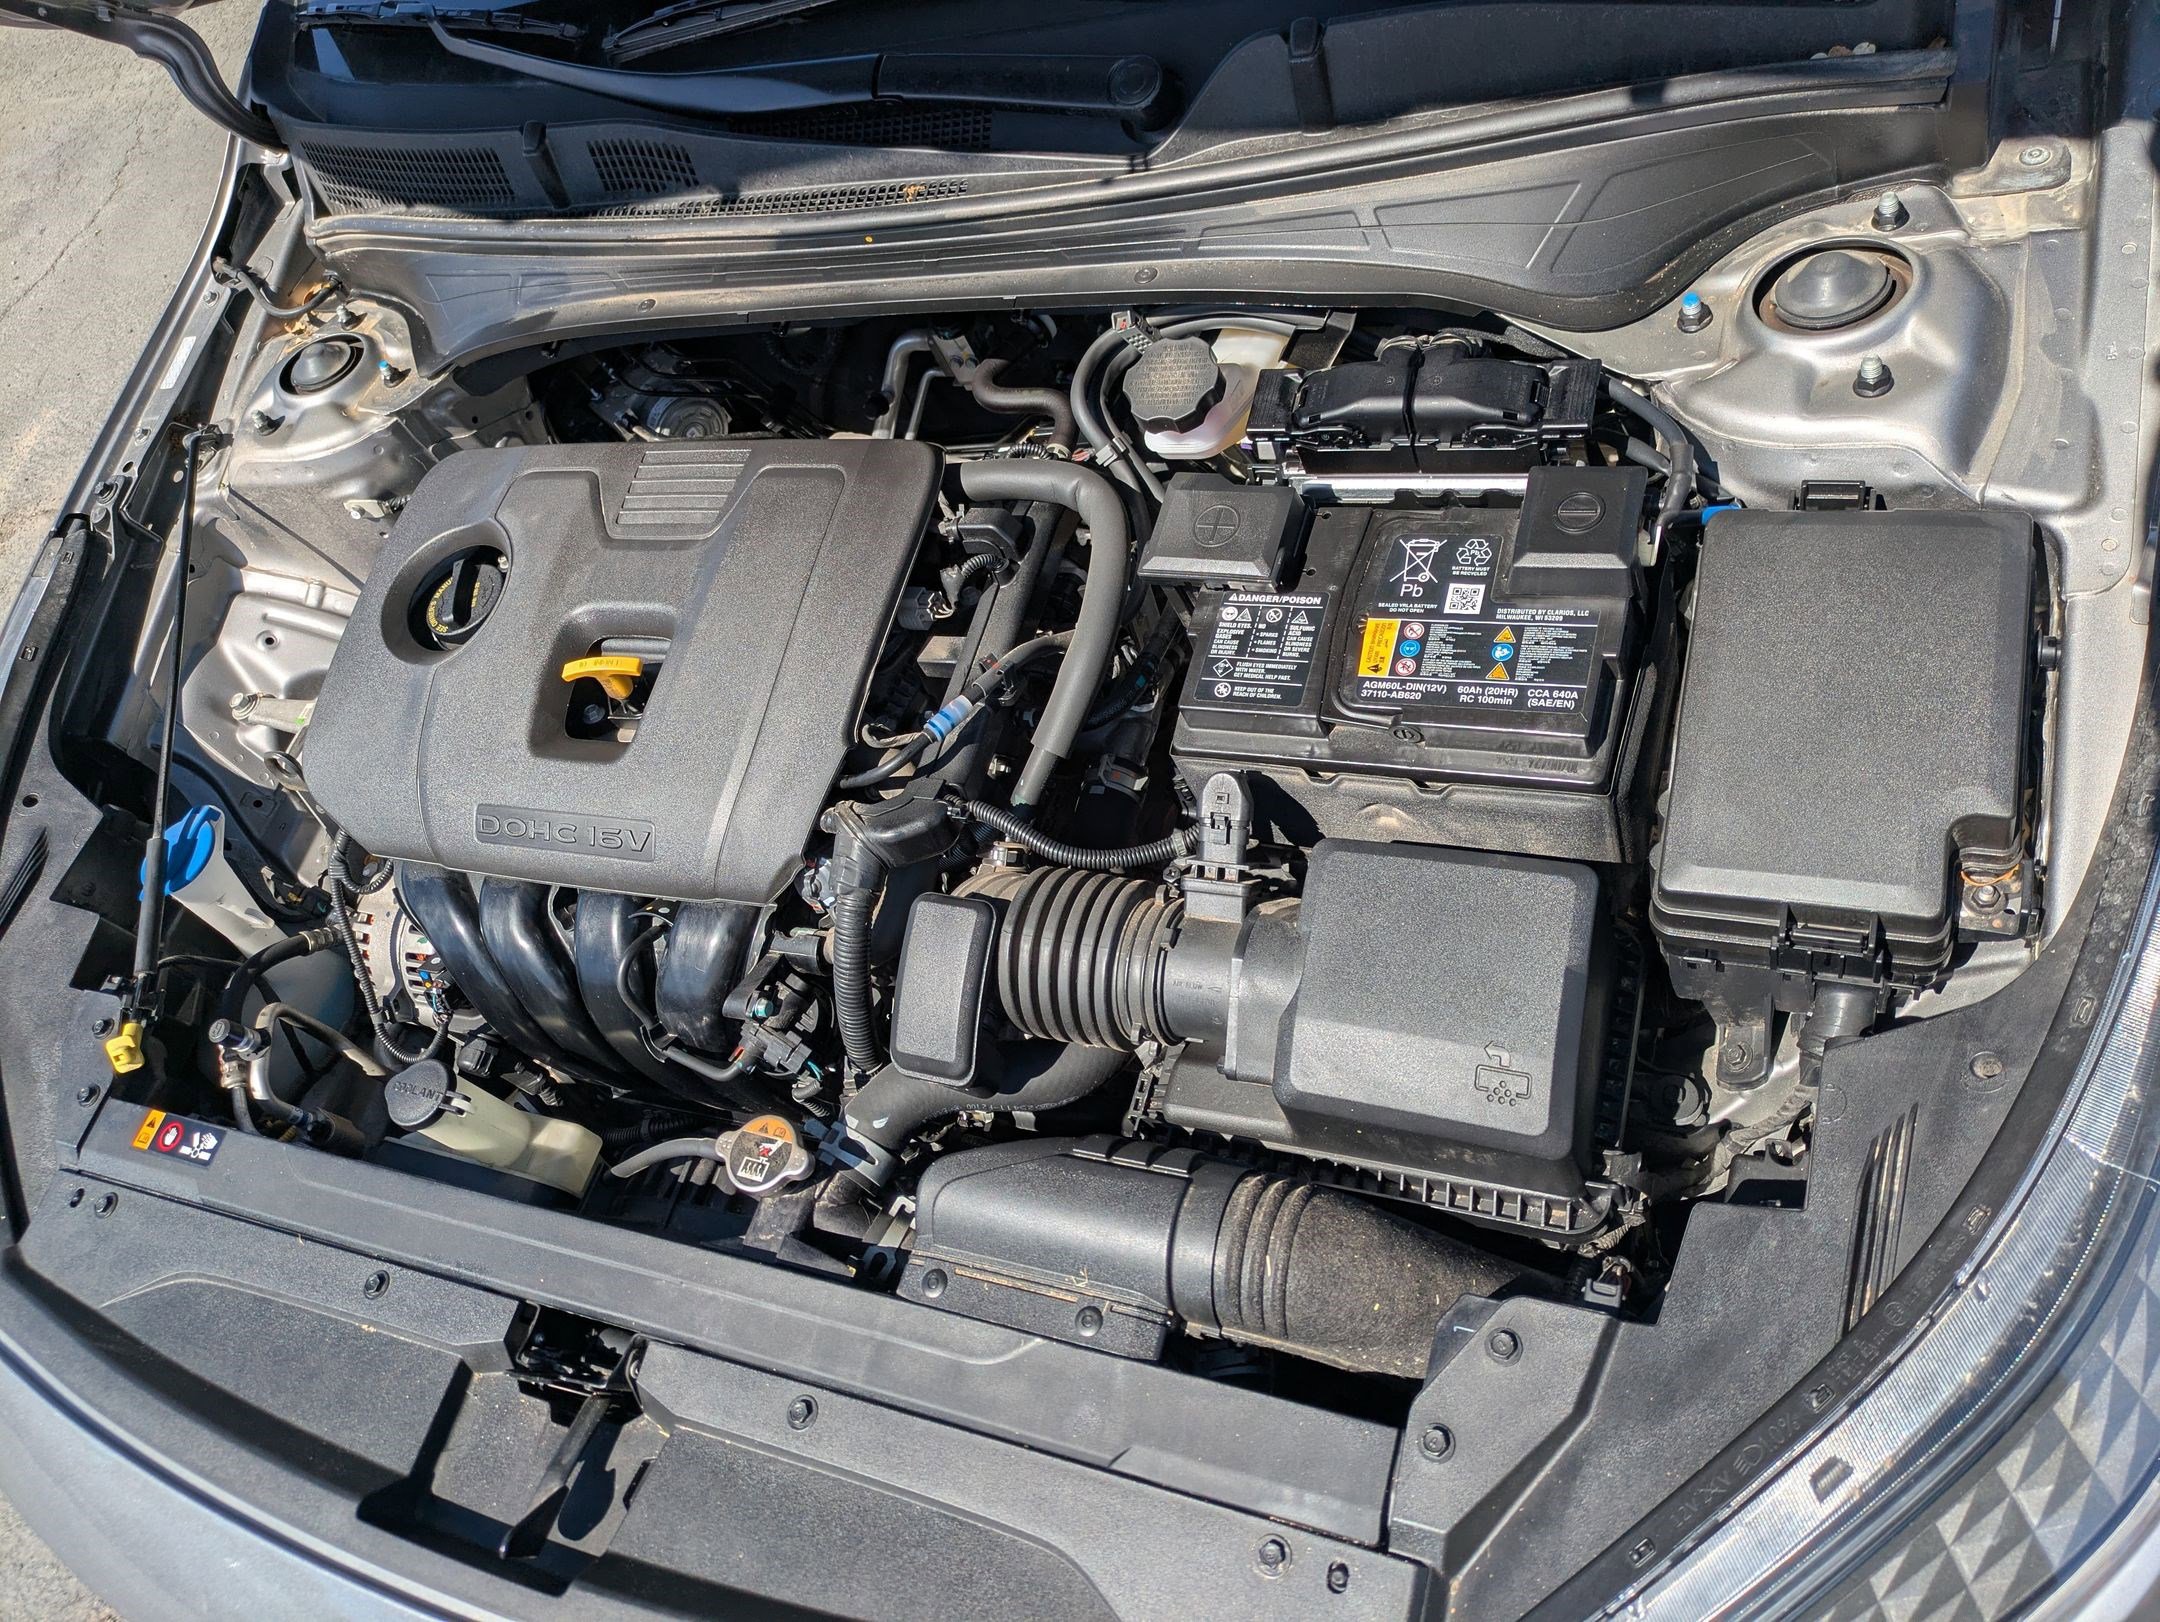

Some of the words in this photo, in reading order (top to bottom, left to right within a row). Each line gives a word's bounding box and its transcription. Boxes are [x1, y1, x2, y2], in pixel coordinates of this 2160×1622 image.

[1400, 583, 1423, 597] Pb
[1238, 594, 1321, 605] DANGER/POISON
[1363, 681, 1447, 694] AGM60L-DIN(12V)
[1457, 686, 1482, 694] 60Ah
[1485, 687, 1519, 698] (20HR)
[1361, 689, 1421, 700] 37110-AB620
[1459, 695, 1475, 703] RC
[1478, 695, 1512, 705] 100min
[1528, 689, 1549, 697] CCA
[1553, 690, 1578, 699] 640A
[1528, 698, 1575, 710] (SAE/EN)
[478, 814, 577, 844] DOHC
[588, 825, 651, 852] 16V
